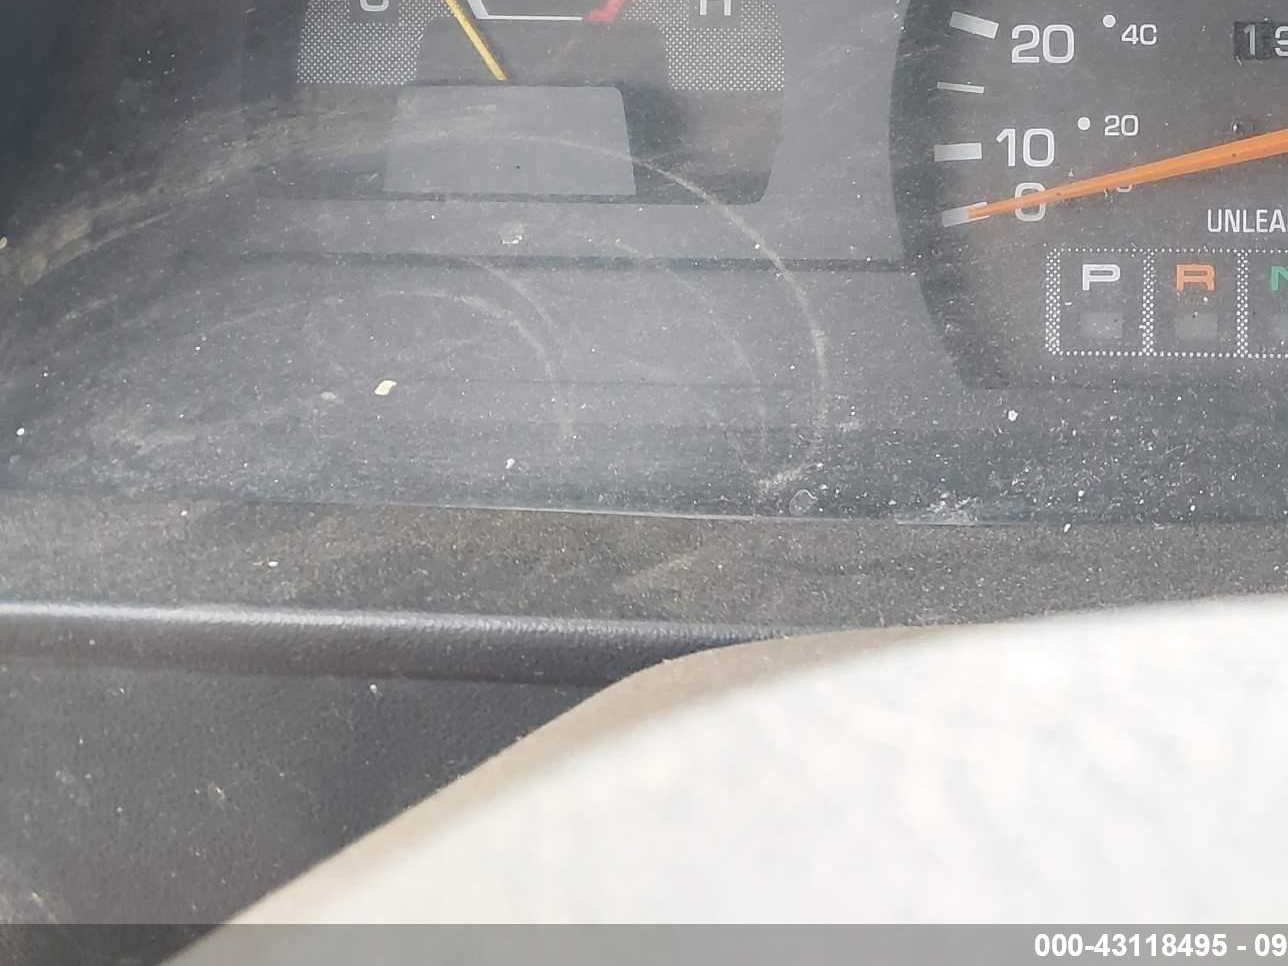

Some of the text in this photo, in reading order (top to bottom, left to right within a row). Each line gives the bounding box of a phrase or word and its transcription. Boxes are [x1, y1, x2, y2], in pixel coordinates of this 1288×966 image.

[1011, 24, 1075, 64] 20
[1103, 114, 1139, 136] 20
[996, 128, 1055, 167] 10
[1014, 183, 1046, 222] 0
[1083, 264, 1121, 291] P
[1176, 264, 1215, 291] R
